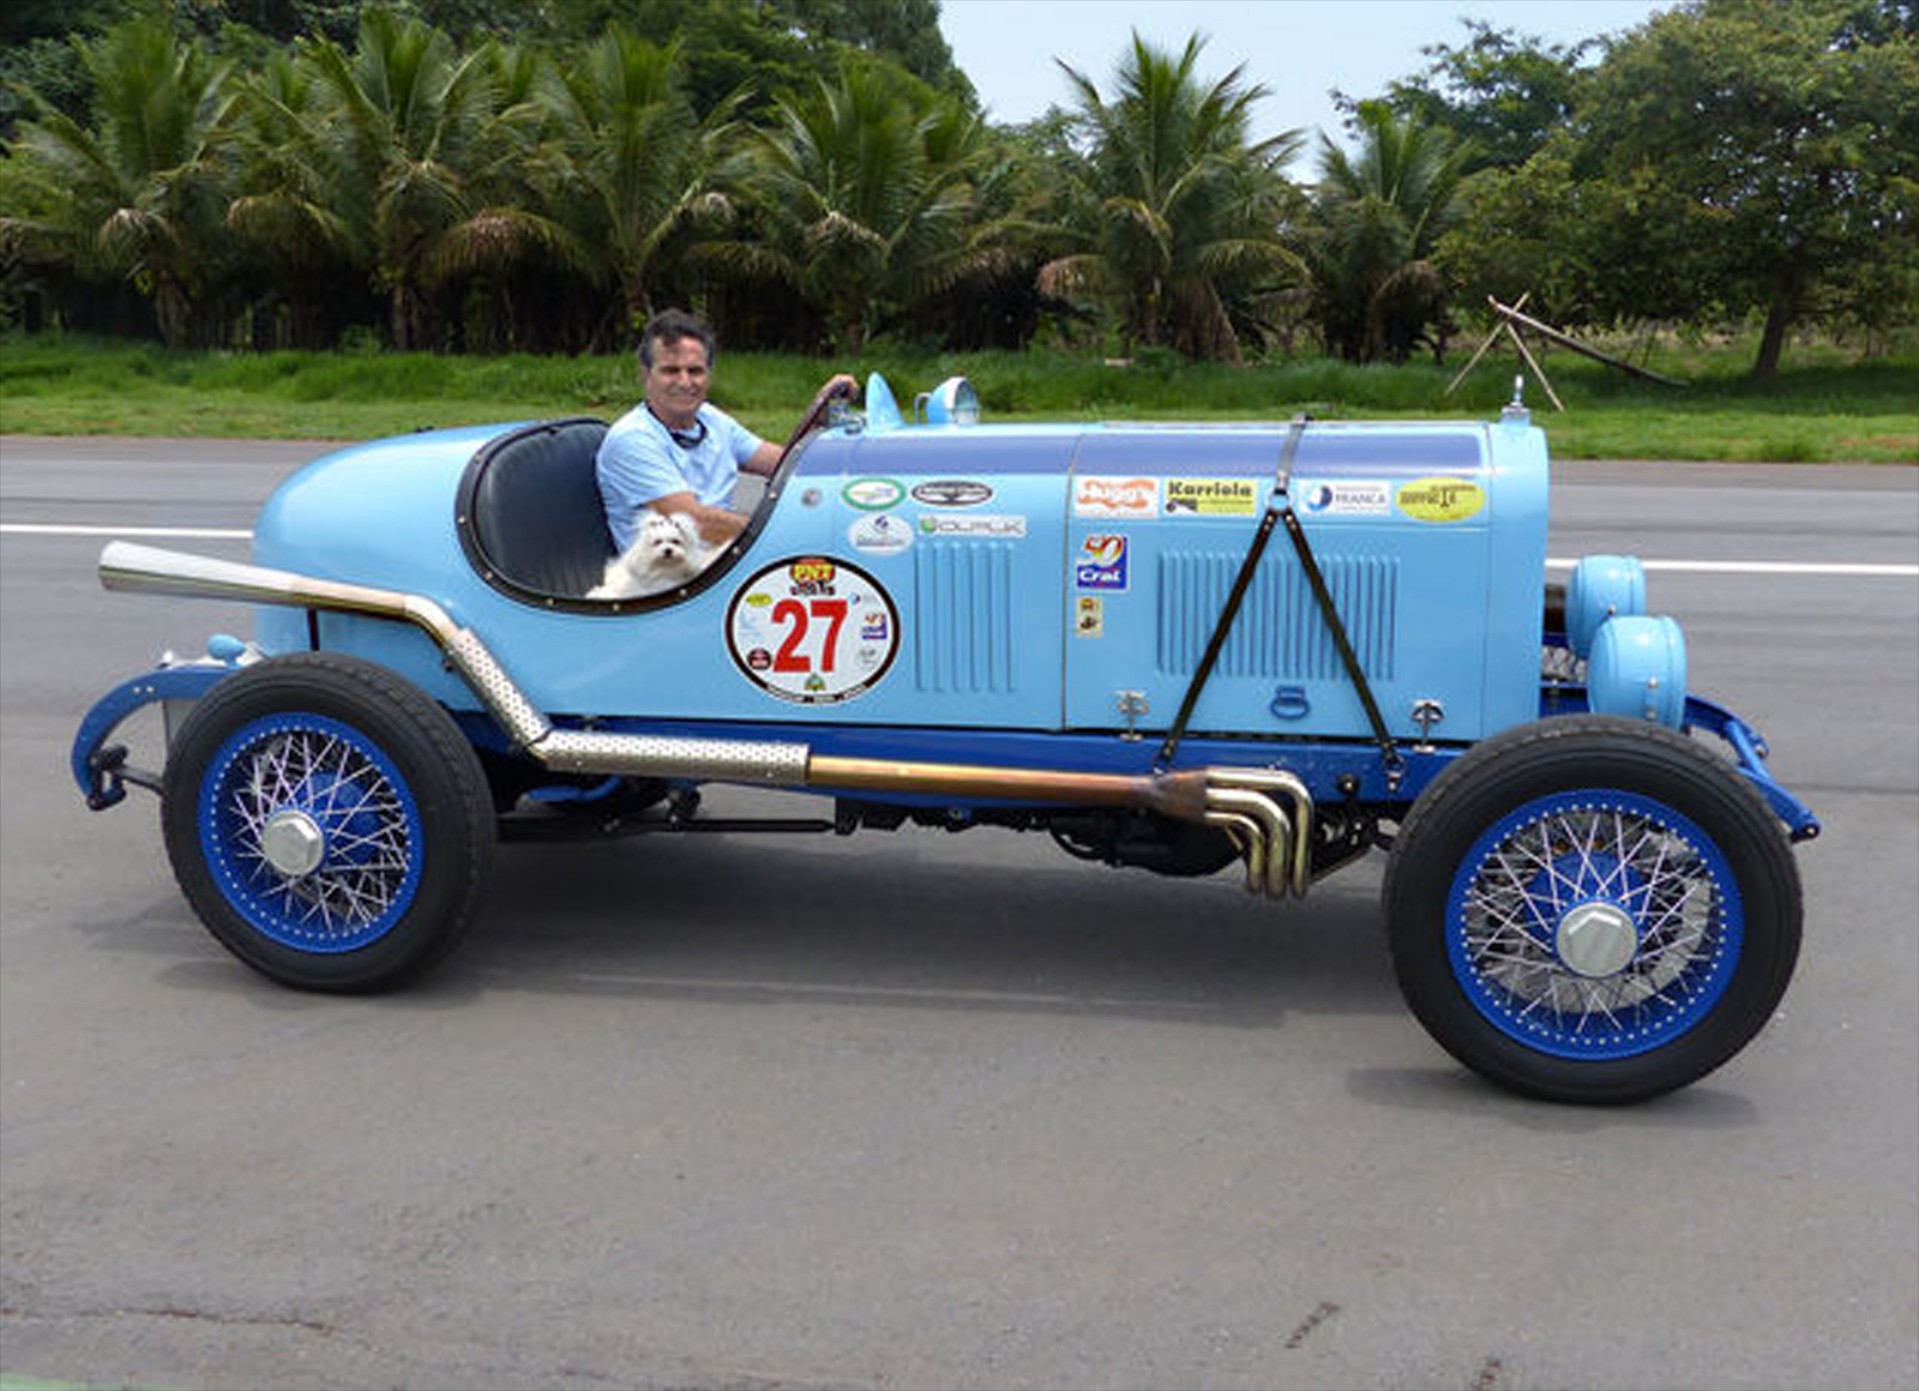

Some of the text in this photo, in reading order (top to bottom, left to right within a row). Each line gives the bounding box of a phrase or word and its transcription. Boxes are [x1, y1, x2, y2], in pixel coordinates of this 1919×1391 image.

[1168, 482, 1253, 497] Karriola
[1079, 567, 1122, 582] Cral
[771, 598, 849, 673] 27
